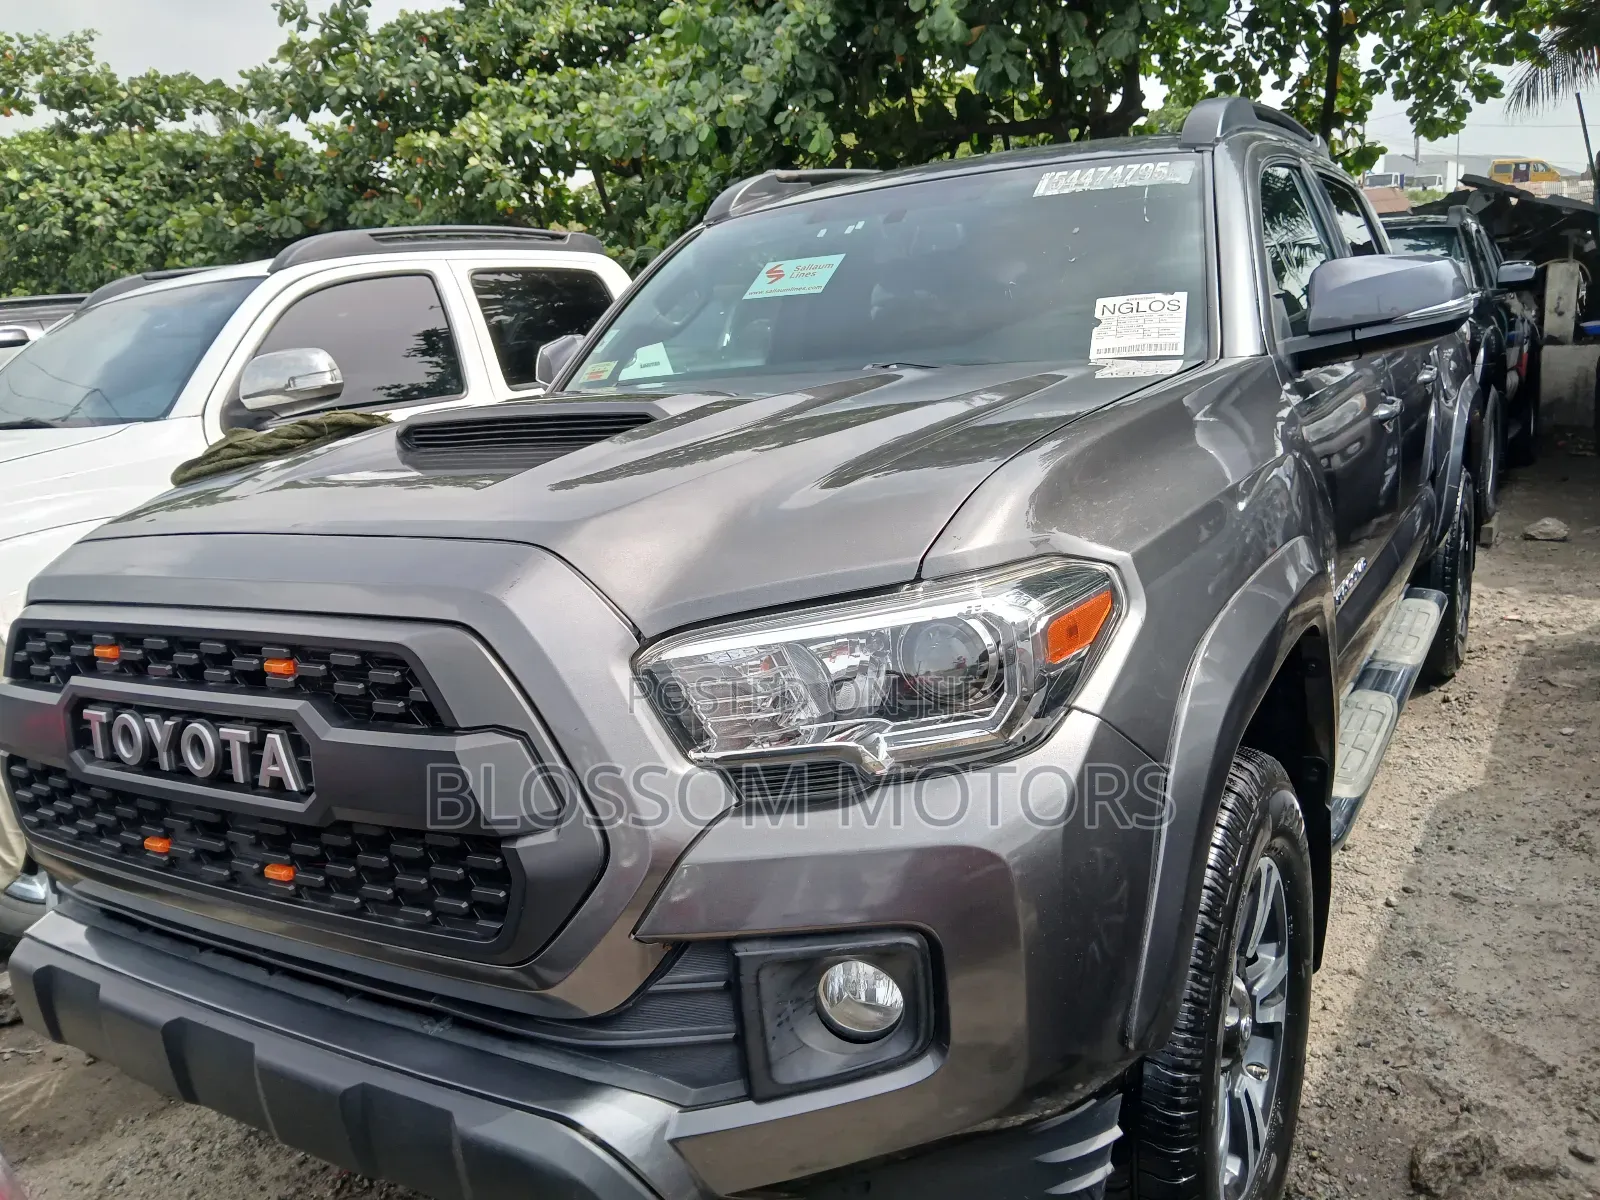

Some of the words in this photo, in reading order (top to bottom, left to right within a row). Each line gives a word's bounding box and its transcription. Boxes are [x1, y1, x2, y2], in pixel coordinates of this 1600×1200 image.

[793, 263, 834, 272] Sallaum
[789, 271, 817, 279] Lines
[748, 285, 822, 295] www.sallaumlines.com
[1101, 299, 1181, 316] NGLOS
[83, 704, 305, 792] TOYOTA
